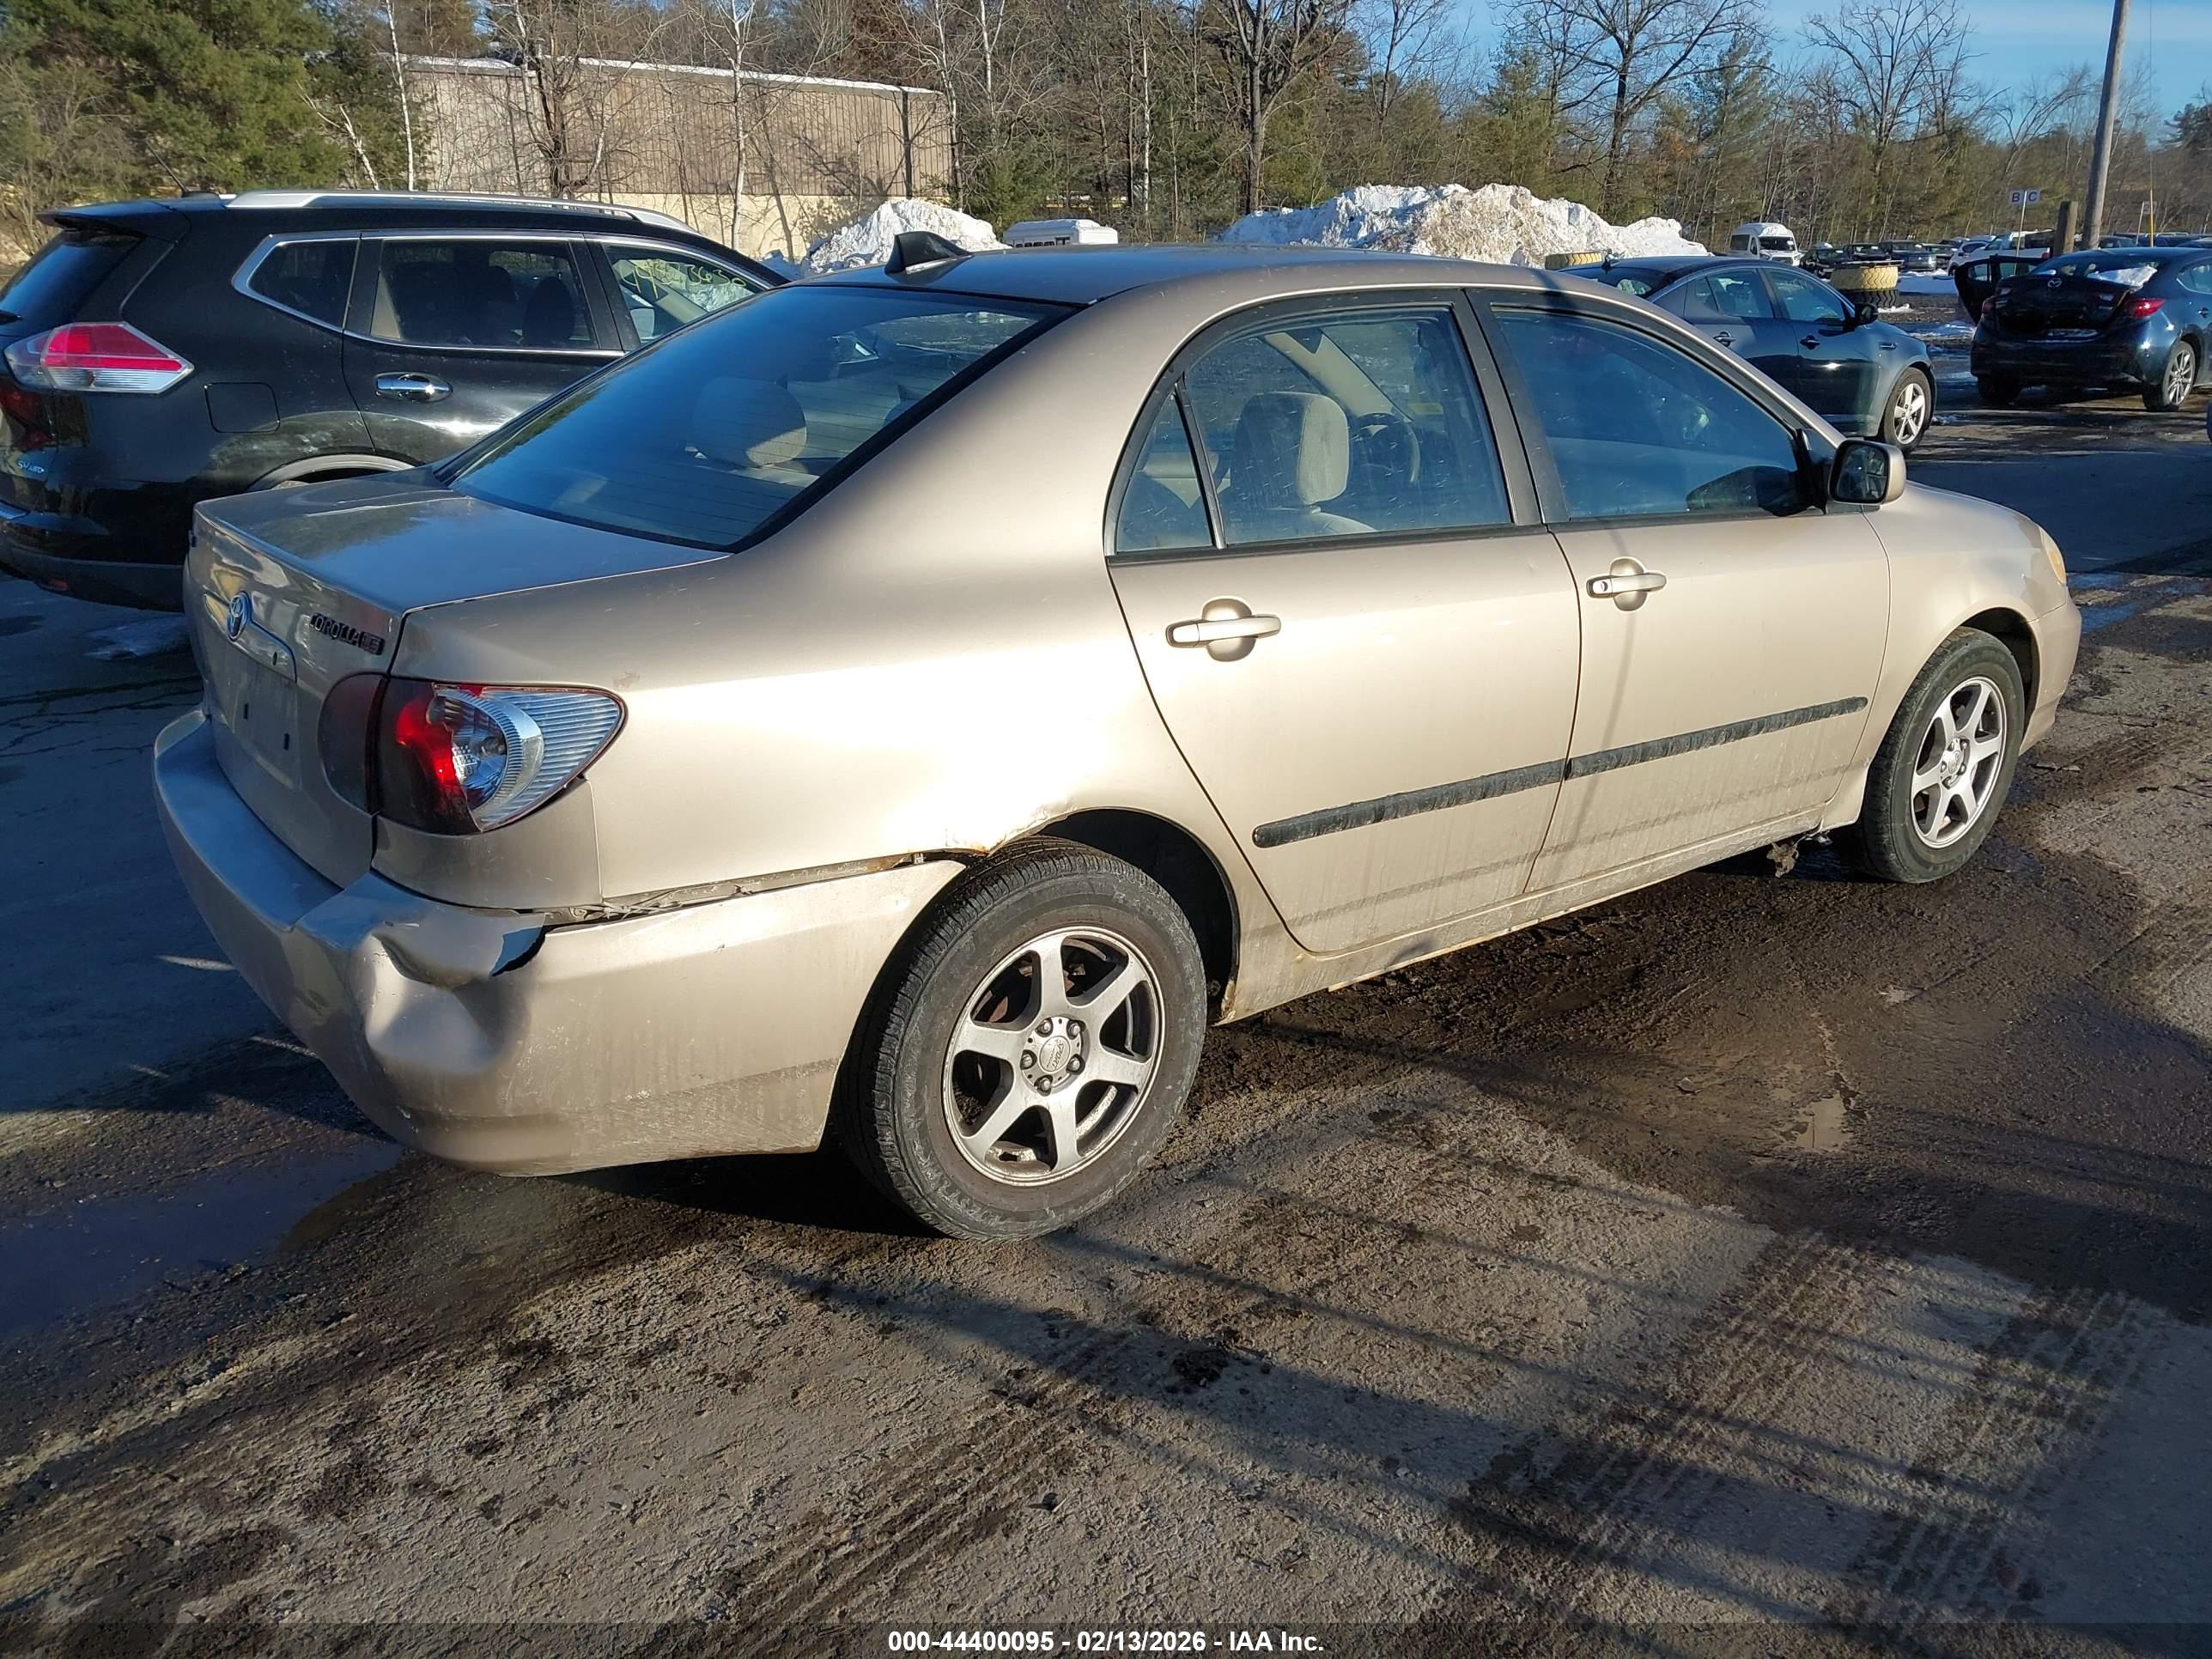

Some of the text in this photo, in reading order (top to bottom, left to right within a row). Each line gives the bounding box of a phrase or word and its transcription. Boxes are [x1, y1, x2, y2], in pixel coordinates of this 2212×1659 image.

[2011, 191, 2038, 203] B C
[309, 611, 360, 647] COROLLA
